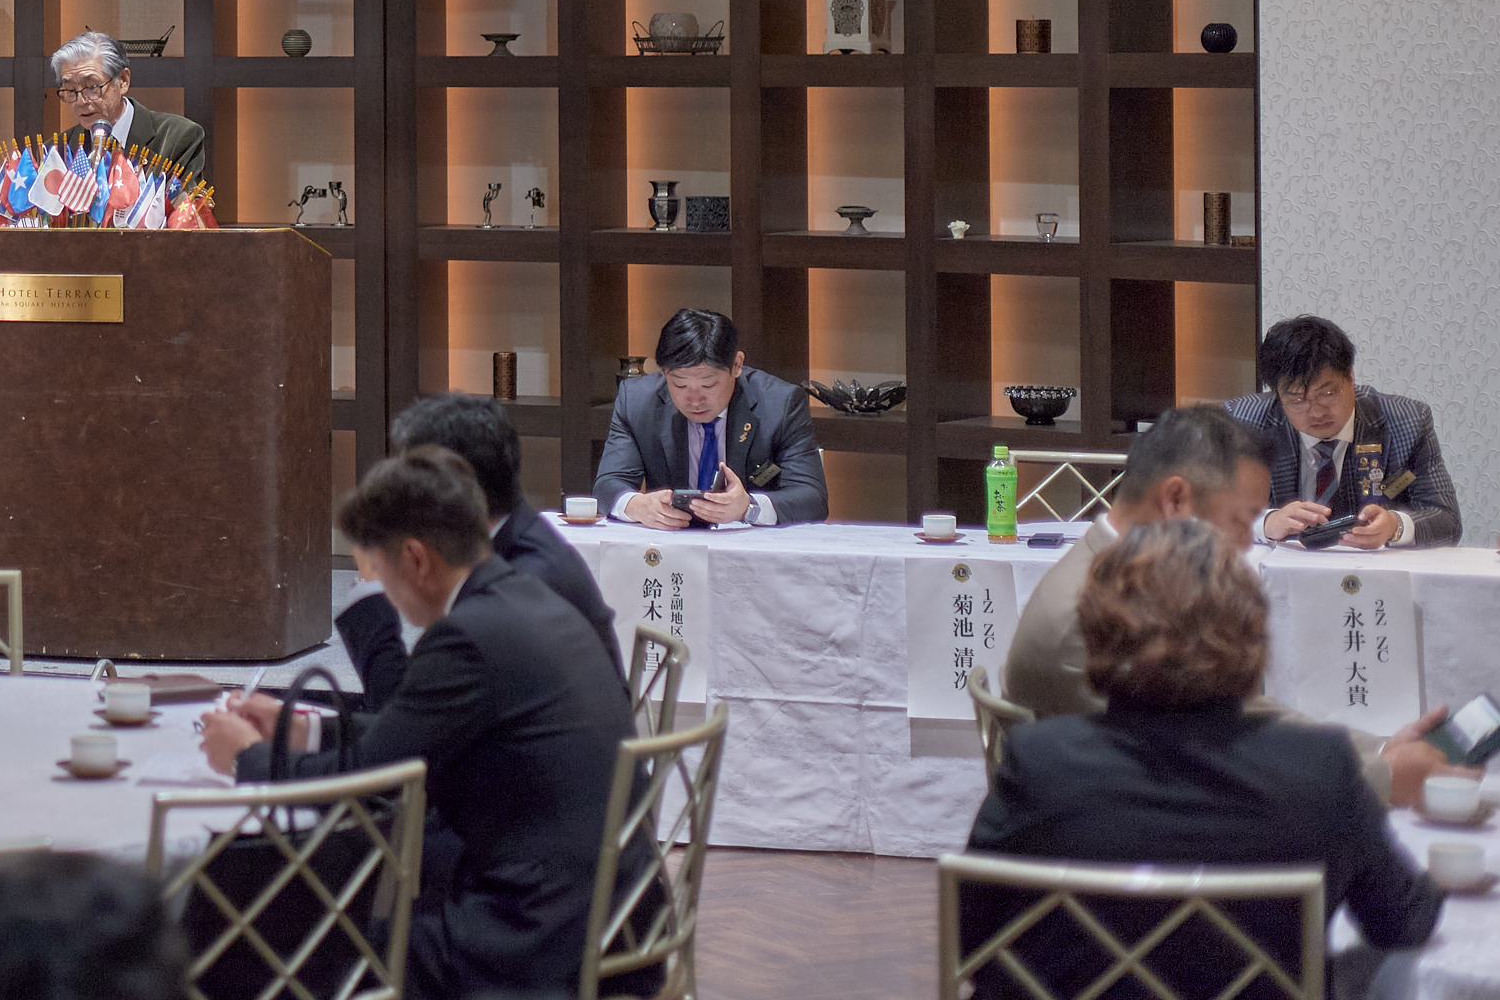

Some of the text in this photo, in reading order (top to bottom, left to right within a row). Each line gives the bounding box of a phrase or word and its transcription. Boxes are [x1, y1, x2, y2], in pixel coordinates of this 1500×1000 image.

[47, 288, 110, 299] TERRACE
[642, 577, 663, 621] 鈴木
[952, 594, 975, 638] 菊池
[983, 588, 995, 650] 1Z ZC
[1343, 606, 1369, 707] 永井 大貴
[1375, 600, 1390, 663] 2Z ZC
